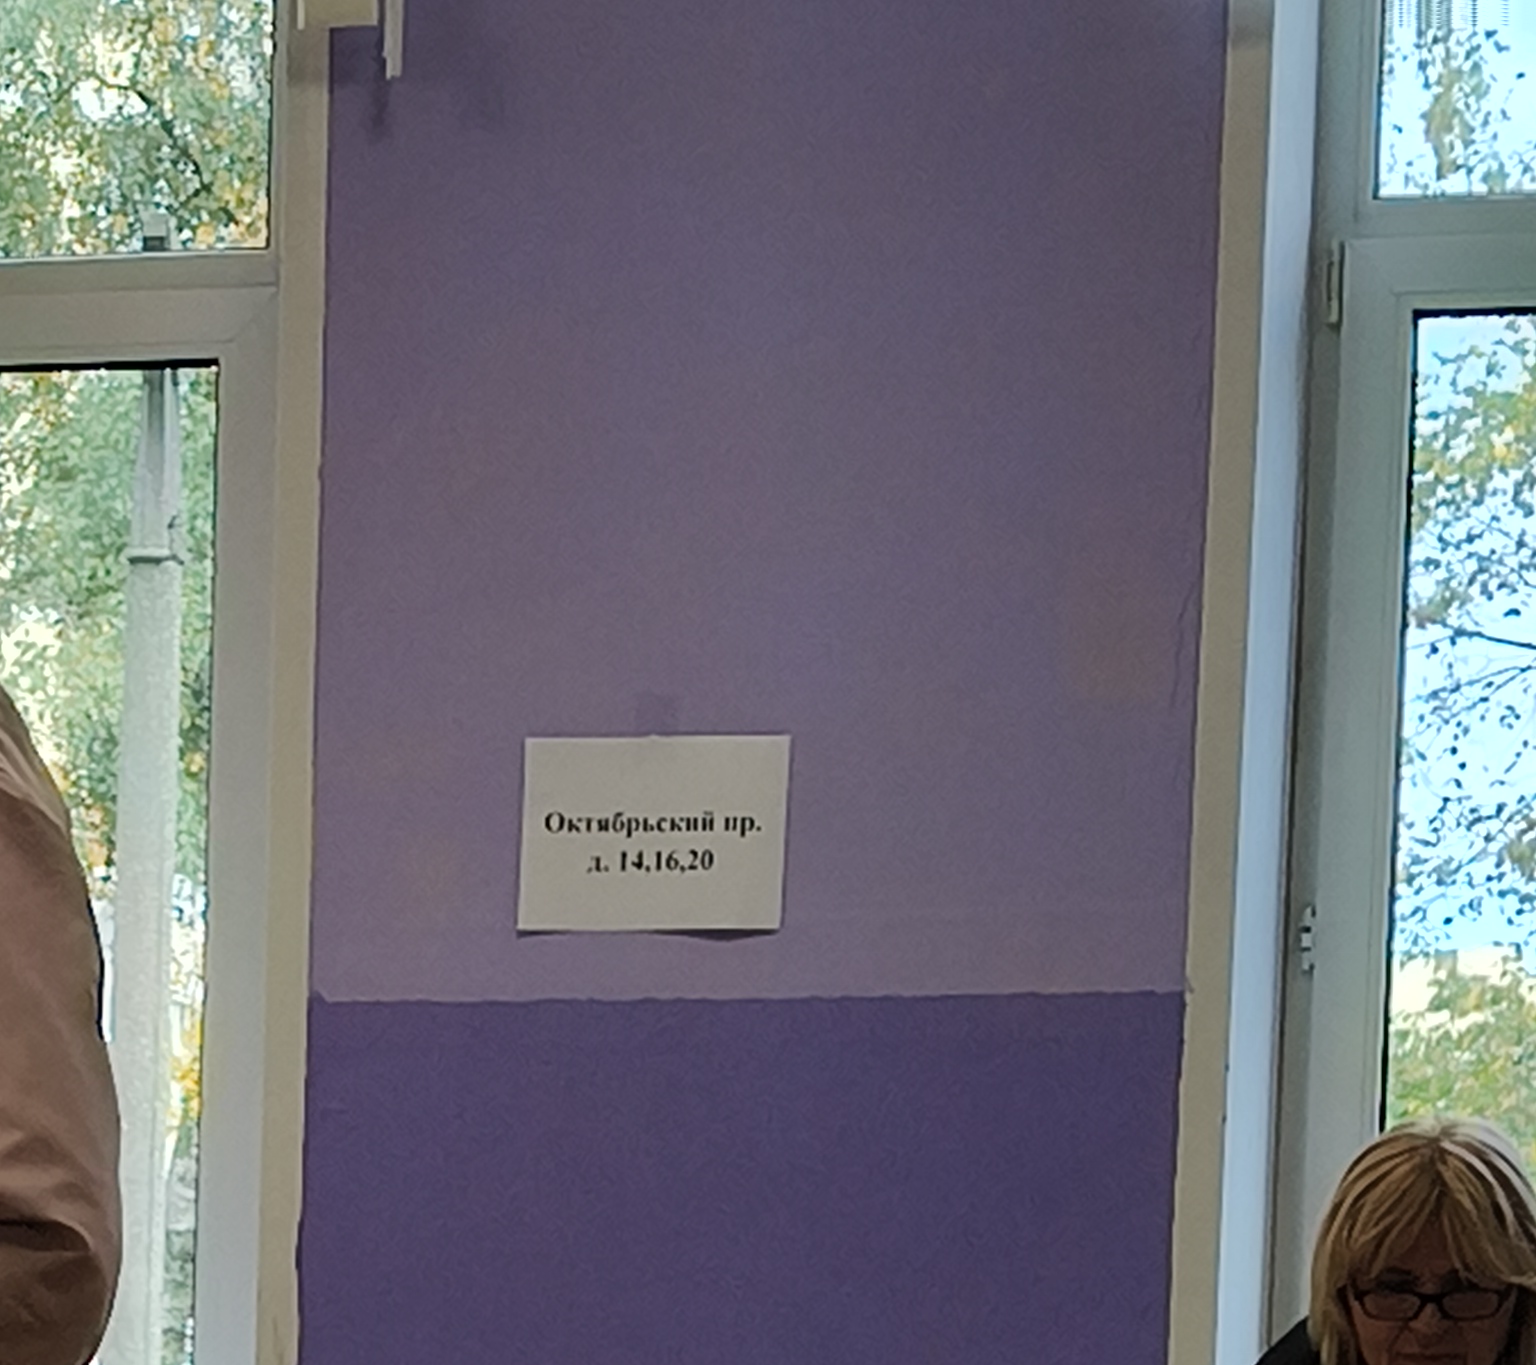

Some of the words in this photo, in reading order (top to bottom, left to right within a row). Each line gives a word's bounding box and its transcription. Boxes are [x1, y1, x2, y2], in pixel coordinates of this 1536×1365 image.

[544, 811, 715, 838] Октябрьский
[723, 815, 762, 838] пр.
[586, 855, 610, 874] д.
[620, 849, 715, 874] 14,16,20
